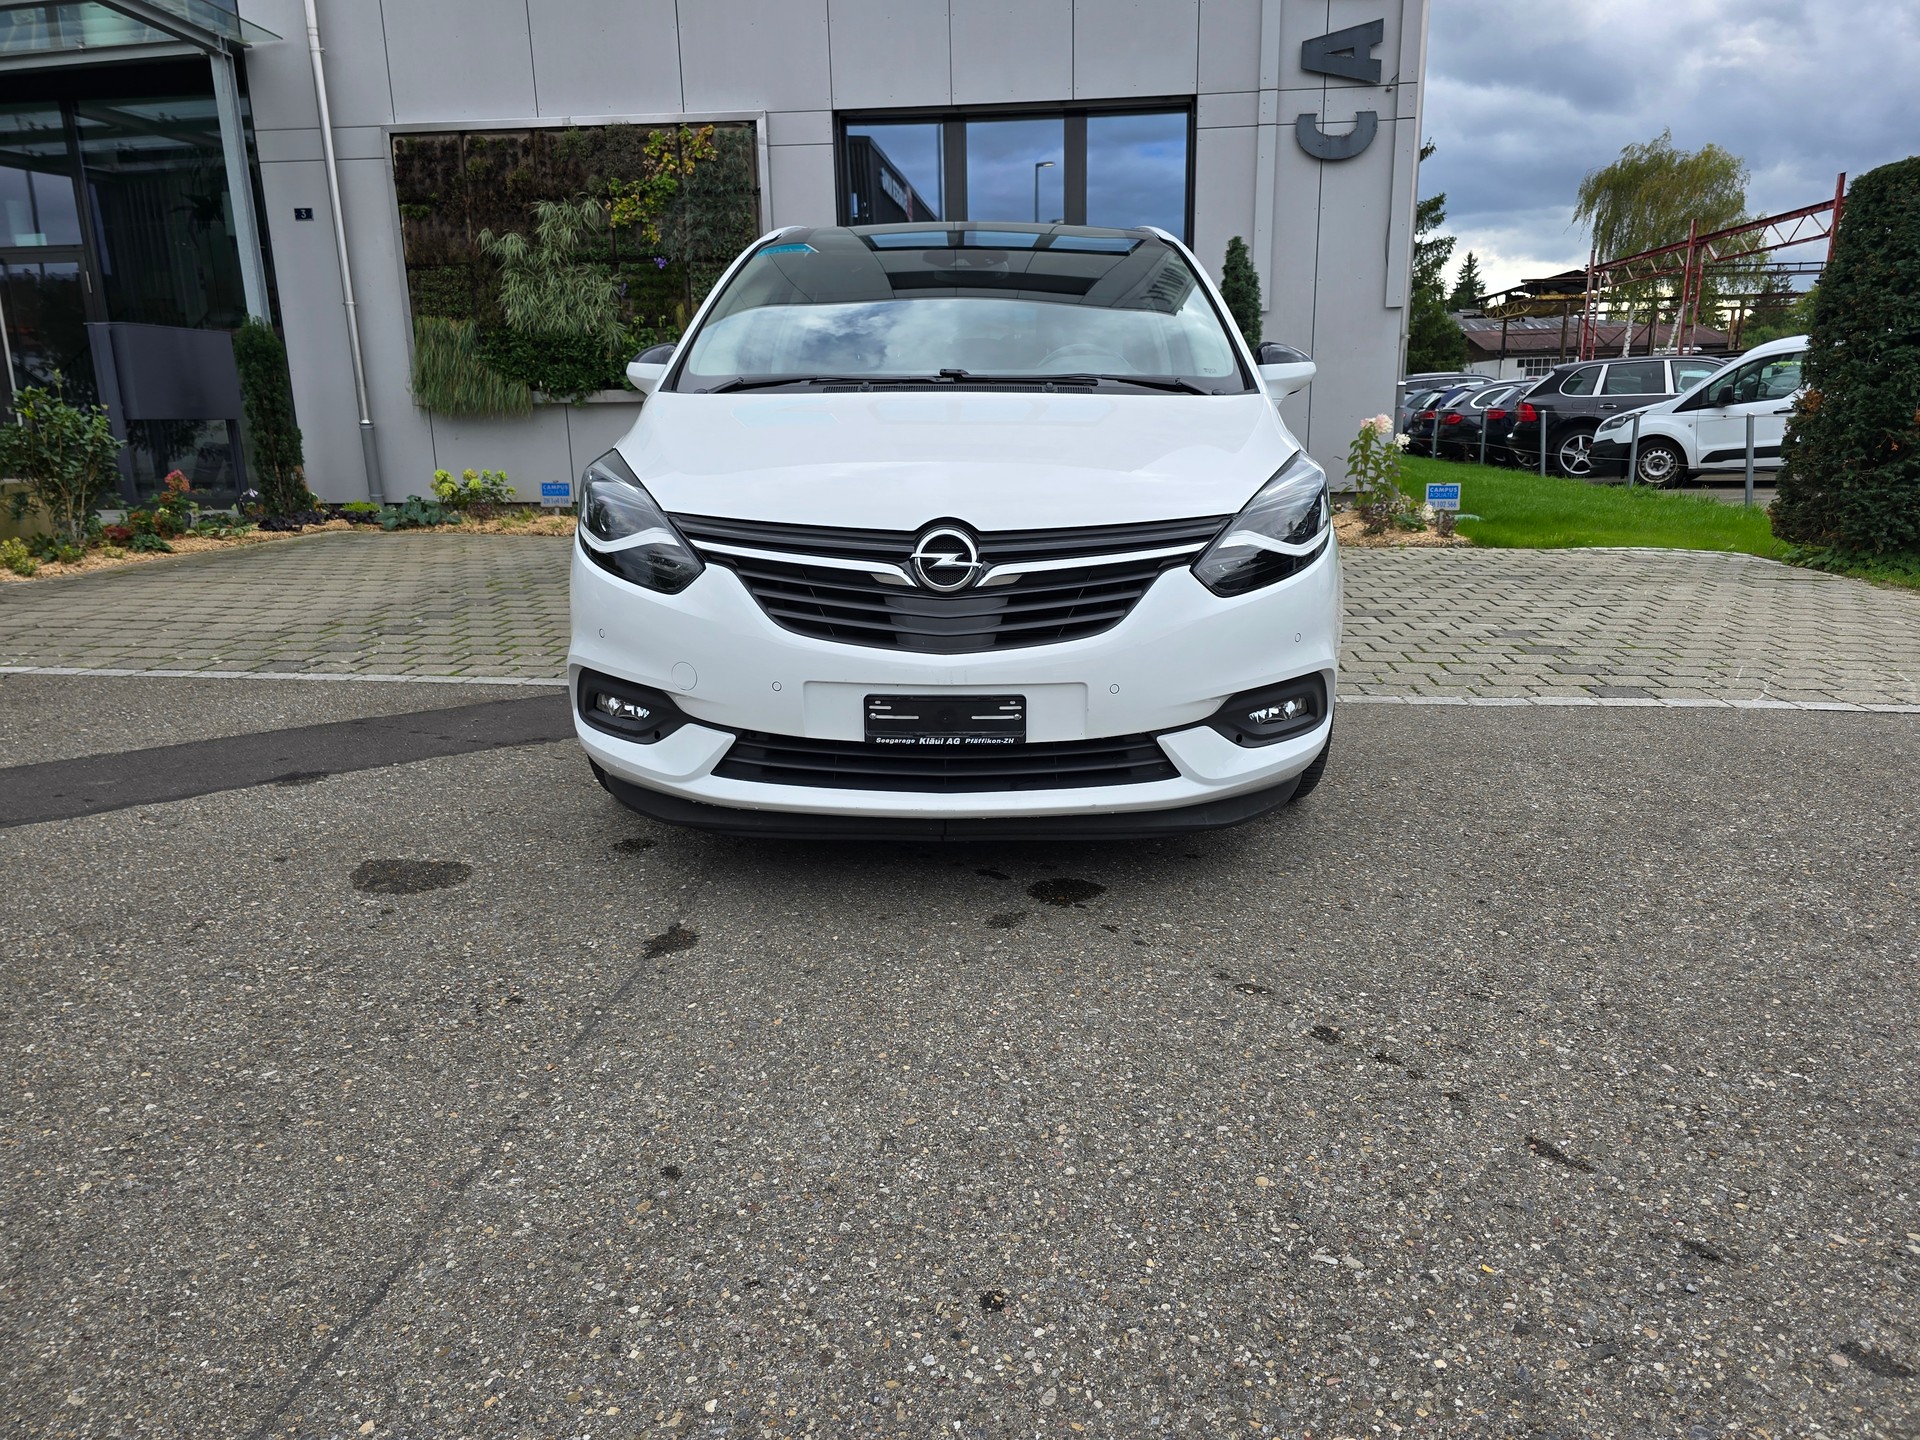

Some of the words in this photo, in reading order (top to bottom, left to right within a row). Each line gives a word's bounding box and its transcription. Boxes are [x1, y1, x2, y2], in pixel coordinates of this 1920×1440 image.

[300, 209, 307, 219] 3
[1437, 500, 1446, 508] 102
[1447, 500, 1457, 508] 566
[876, 737, 916, 745] Seegarage
[946, 737, 961, 745] AG
